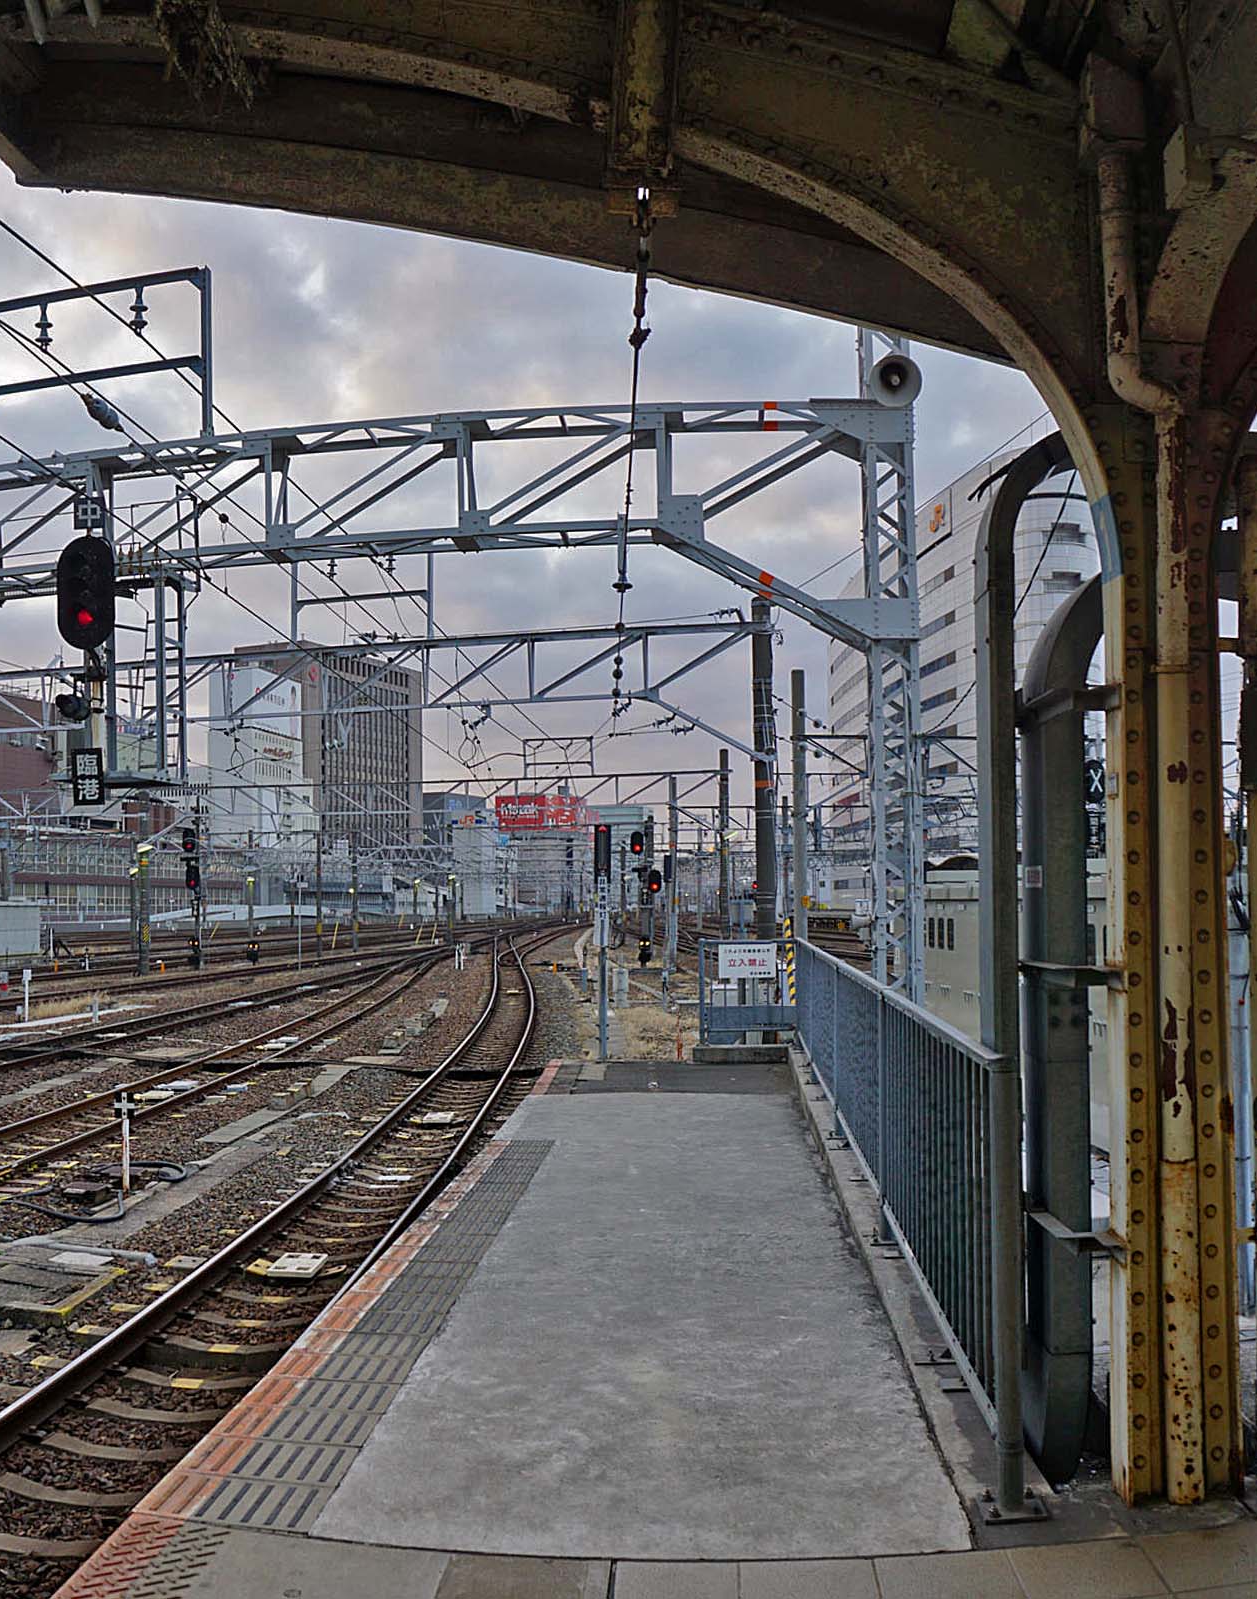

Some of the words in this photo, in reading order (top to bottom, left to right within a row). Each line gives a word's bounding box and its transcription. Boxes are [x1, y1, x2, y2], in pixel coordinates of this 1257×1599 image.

[79, 500, 101, 526] 中
[929, 503, 943, 534] JR
[76, 753, 100, 800] 臨港
[728, 958, 768, 967] 立入禁止
